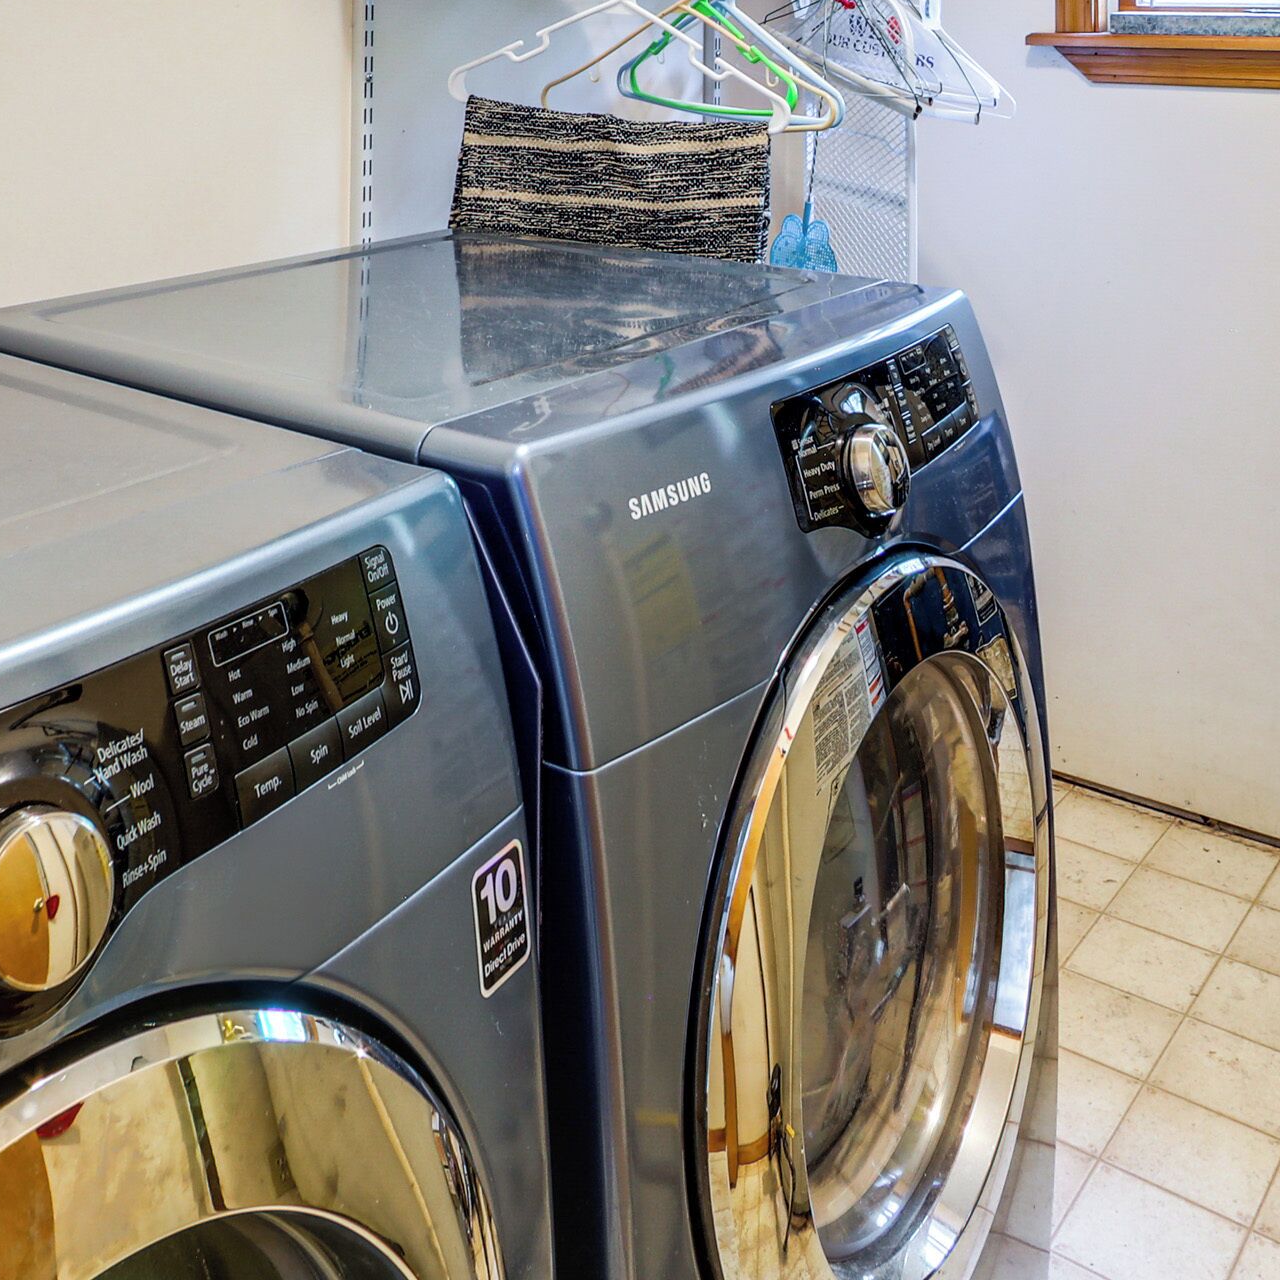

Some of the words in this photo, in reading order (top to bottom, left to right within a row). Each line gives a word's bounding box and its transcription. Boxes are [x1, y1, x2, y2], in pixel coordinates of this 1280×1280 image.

[798, 444, 818, 458] Normal
[803, 466, 820, 478] Heavy
[820, 461, 835, 473] Duty
[628, 472, 712, 520] SAMSUNG
[809, 488, 824, 500] Perm
[824, 483, 840, 495] Press
[814, 505, 839, 522] Delicates
[365, 551, 385, 570] Signal
[368, 565, 390, 583] On/Off
[376, 594, 397, 612] Power
[331, 611, 348, 625] Heavy
[282, 637, 297, 653] High
[336, 629, 356, 647] Normal
[170, 659, 193, 677] Delay
[286, 656, 311, 675] Medium
[340, 654, 355, 669] Light
[390, 650, 409, 670] Start/
[174, 672, 195, 690] Start
[228, 669, 242, 682] Hot
[392, 665, 412, 682] Pause
[232, 688, 253, 704] Warm
[291, 683, 305, 696] Low
[238, 716, 250, 728] Eco
[250, 706, 270, 722] Warm
[296, 707, 305, 719] No
[305, 699, 319, 715] Spin
[180, 714, 206, 735] Steam
[348, 720, 363, 739] Soil
[363, 706, 382, 729] Level
[97, 728, 144, 763] Delicates/
[243, 733, 259, 751] Cold
[120, 746, 148, 770] Wash
[310, 744, 329, 764] Spin
[191, 762, 209, 779] Pure
[130, 773, 155, 799] Wool
[254, 775, 282, 799] Temp.
[116, 826, 138, 851] Quick
[137, 811, 162, 836] Wash
[122, 848, 167, 889] Rinse+Spin
[480, 858, 518, 925] 10
[483, 909, 524, 953] WARRANTY
[484, 951, 507, 979] Direct
[506, 933, 526, 958] Drive
